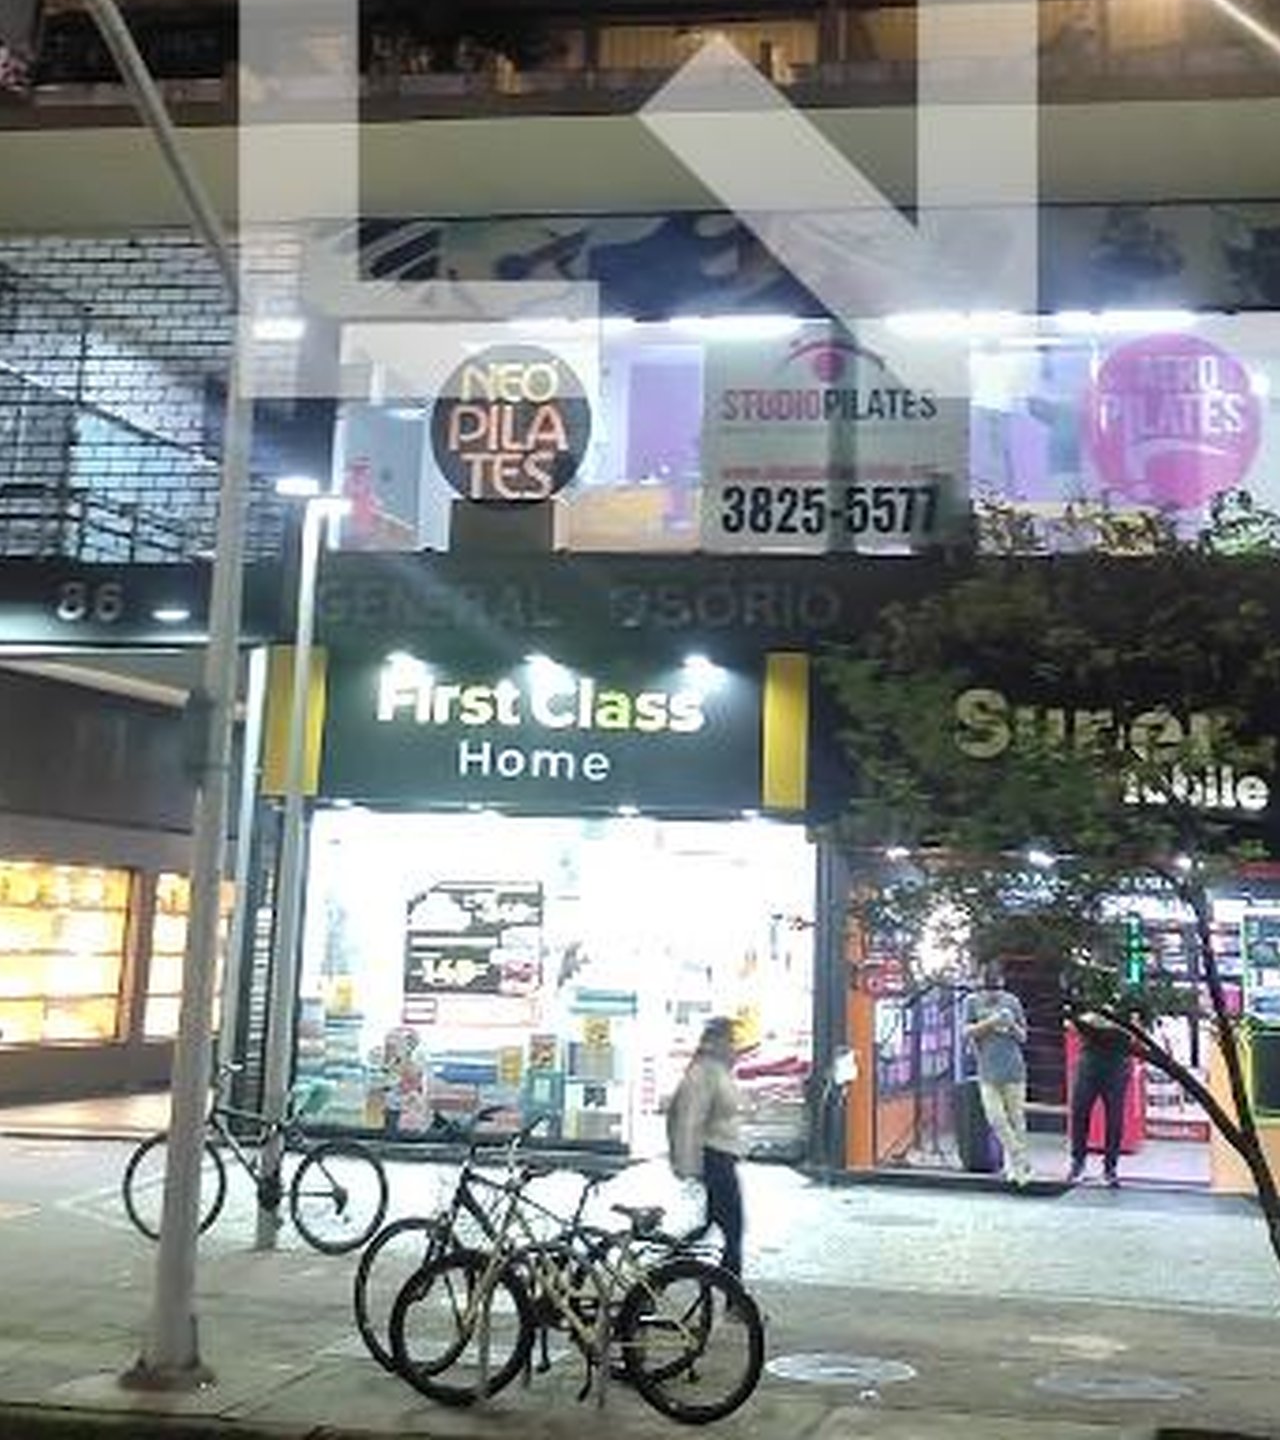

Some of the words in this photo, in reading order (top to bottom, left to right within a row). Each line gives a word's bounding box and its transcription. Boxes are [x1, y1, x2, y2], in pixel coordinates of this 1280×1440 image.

[461, 361, 559, 402] NEO
[448, 405, 568, 452] PILA
[460, 451, 554, 500] TES
[721, 484, 939, 535] 3825-5577
[55, 581, 120, 621] 86
[376, 670, 521, 725] First
[530, 672, 705, 733] Class
[458, 740, 611, 782] Home
